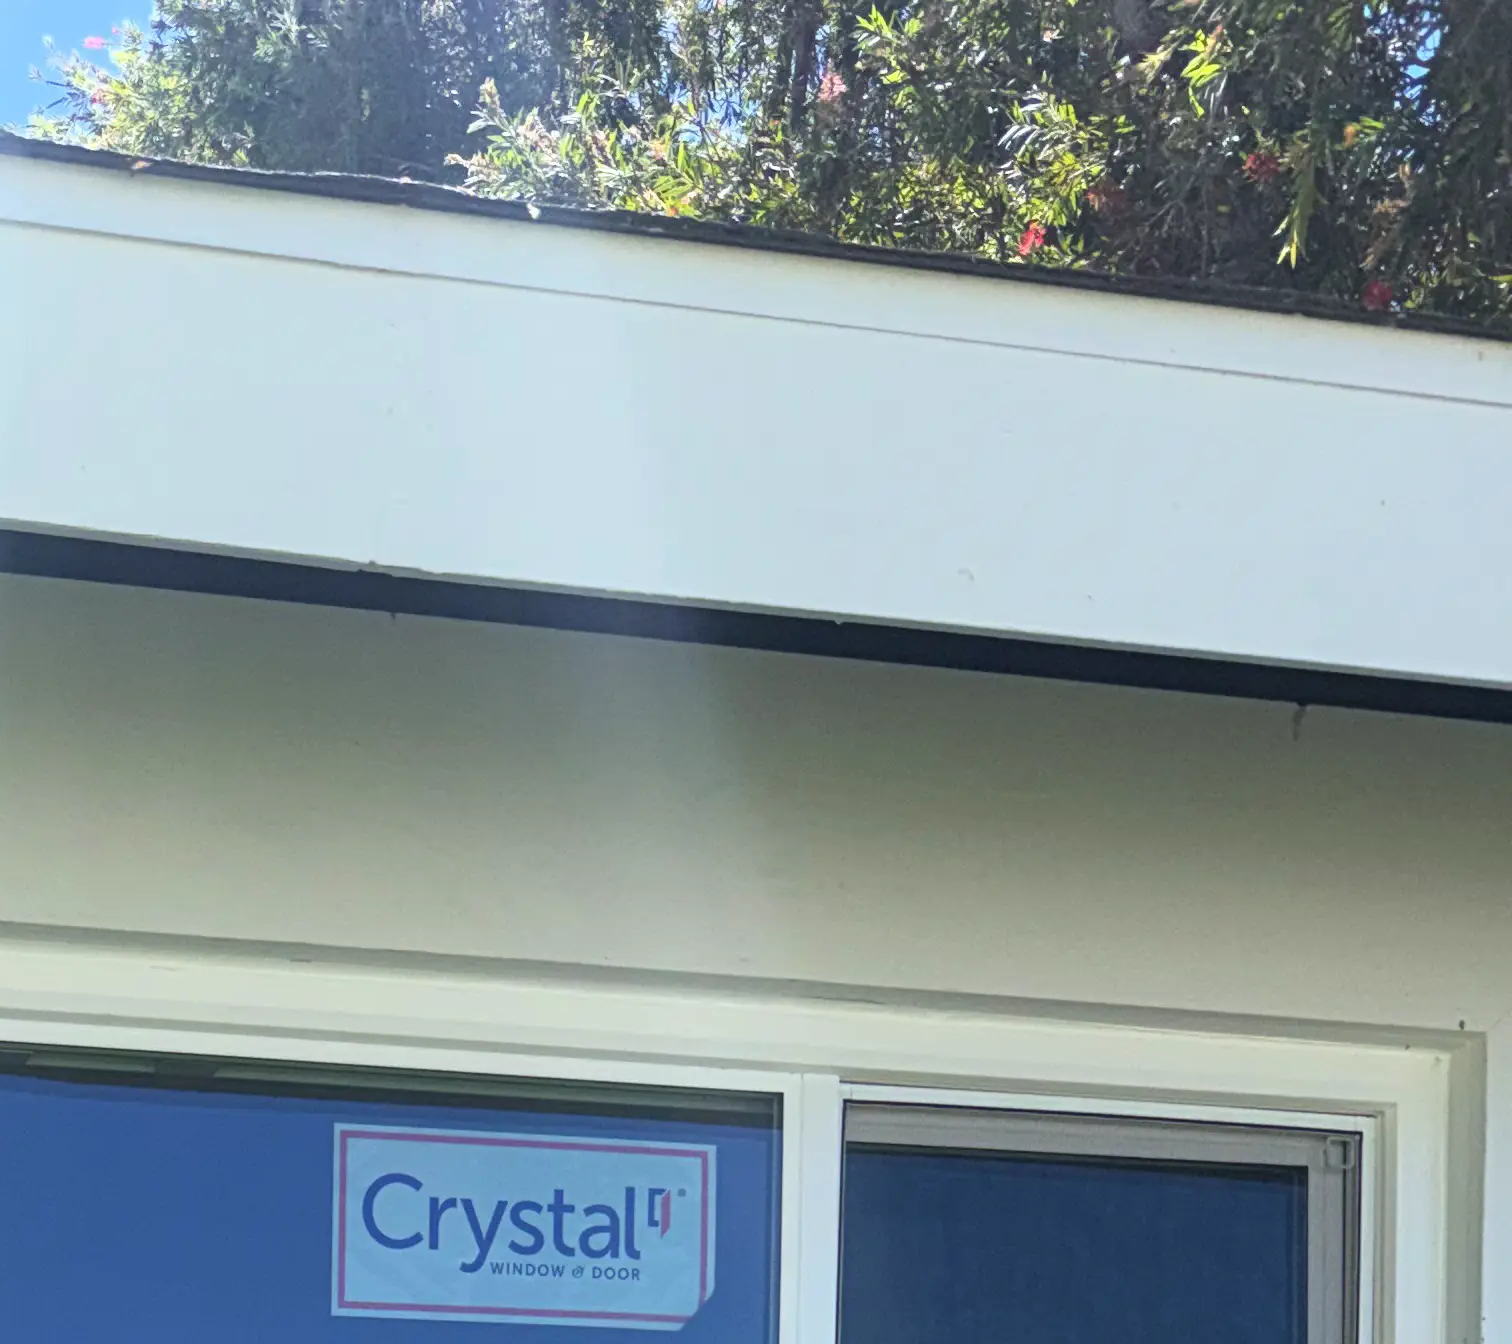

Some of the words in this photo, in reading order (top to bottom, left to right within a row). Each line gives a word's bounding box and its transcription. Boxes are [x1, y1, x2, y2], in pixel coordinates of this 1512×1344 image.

[362, 1173, 641, 1273] Crystal
[490, 1262, 565, 1278] WINDOW
[592, 1266, 641, 1281] DOOR
